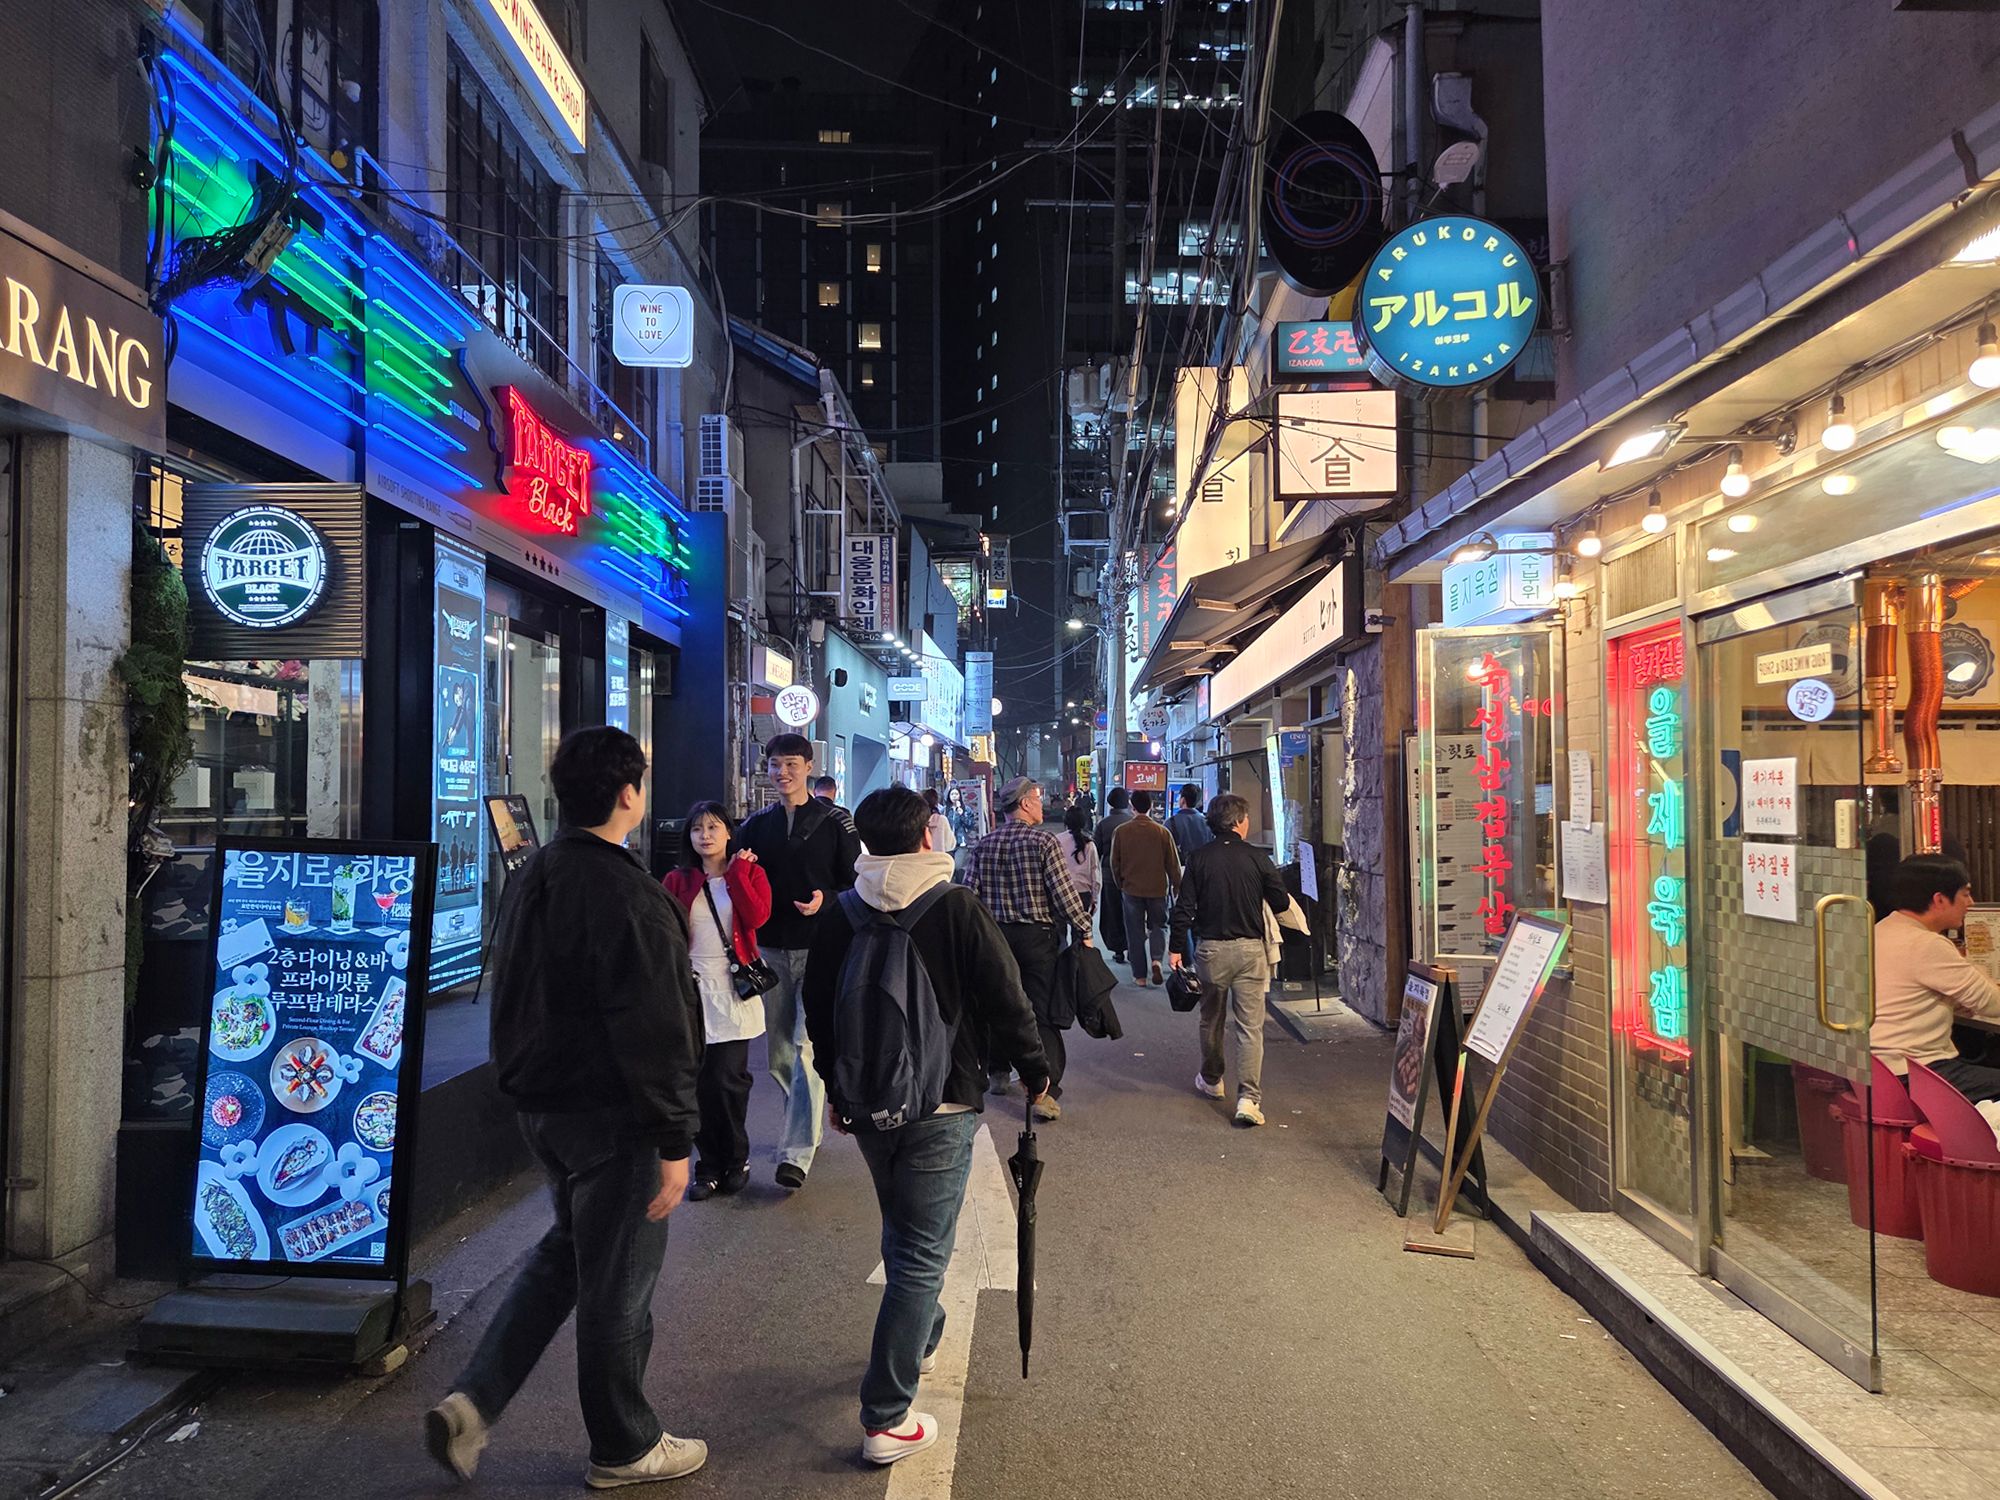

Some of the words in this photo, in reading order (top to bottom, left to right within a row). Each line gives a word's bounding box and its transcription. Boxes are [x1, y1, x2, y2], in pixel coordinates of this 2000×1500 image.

[511, 0, 534, 52] WINE
[535, 33, 552, 82] BAR
[554, 69, 560, 93] &
[561, 76, 581, 123] SHOP
[1311, 257, 1334, 273] 2F
[1378, 225, 1518, 281] ARUKORU
[639, 304, 663, 314] WINE
[646, 317, 657, 327] TO
[1370, 282, 1533, 333] アルコル
[0, 276, 152, 408] RANG
[638, 330, 663, 340] LOVE
[1289, 359, 1325, 367] IZAKAYA
[1400, 343, 1511, 377] IZAKAYA
[510, 384, 592, 515] TARGET
[528, 476, 574, 532] Black
[216, 555, 309, 581] TARGET
[992, 549, 1006, 580] 부동산
[245, 584, 280, 594] BLACK
[850, 540, 877, 631] 대웅문화인쇄
[1449, 559, 1499, 612] 을지육점
[1320, 588, 1338, 631] ヒット
[1303, 624, 1316, 645] HITTO
[1954, 630, 1979, 648] FRESH
[893, 683, 921, 692] CODE
[1465, 651, 1515, 935] 숙성삼겹목살
[237, 850, 333, 889] 을지로
[1645, 687, 1685, 1039] 을지육점
